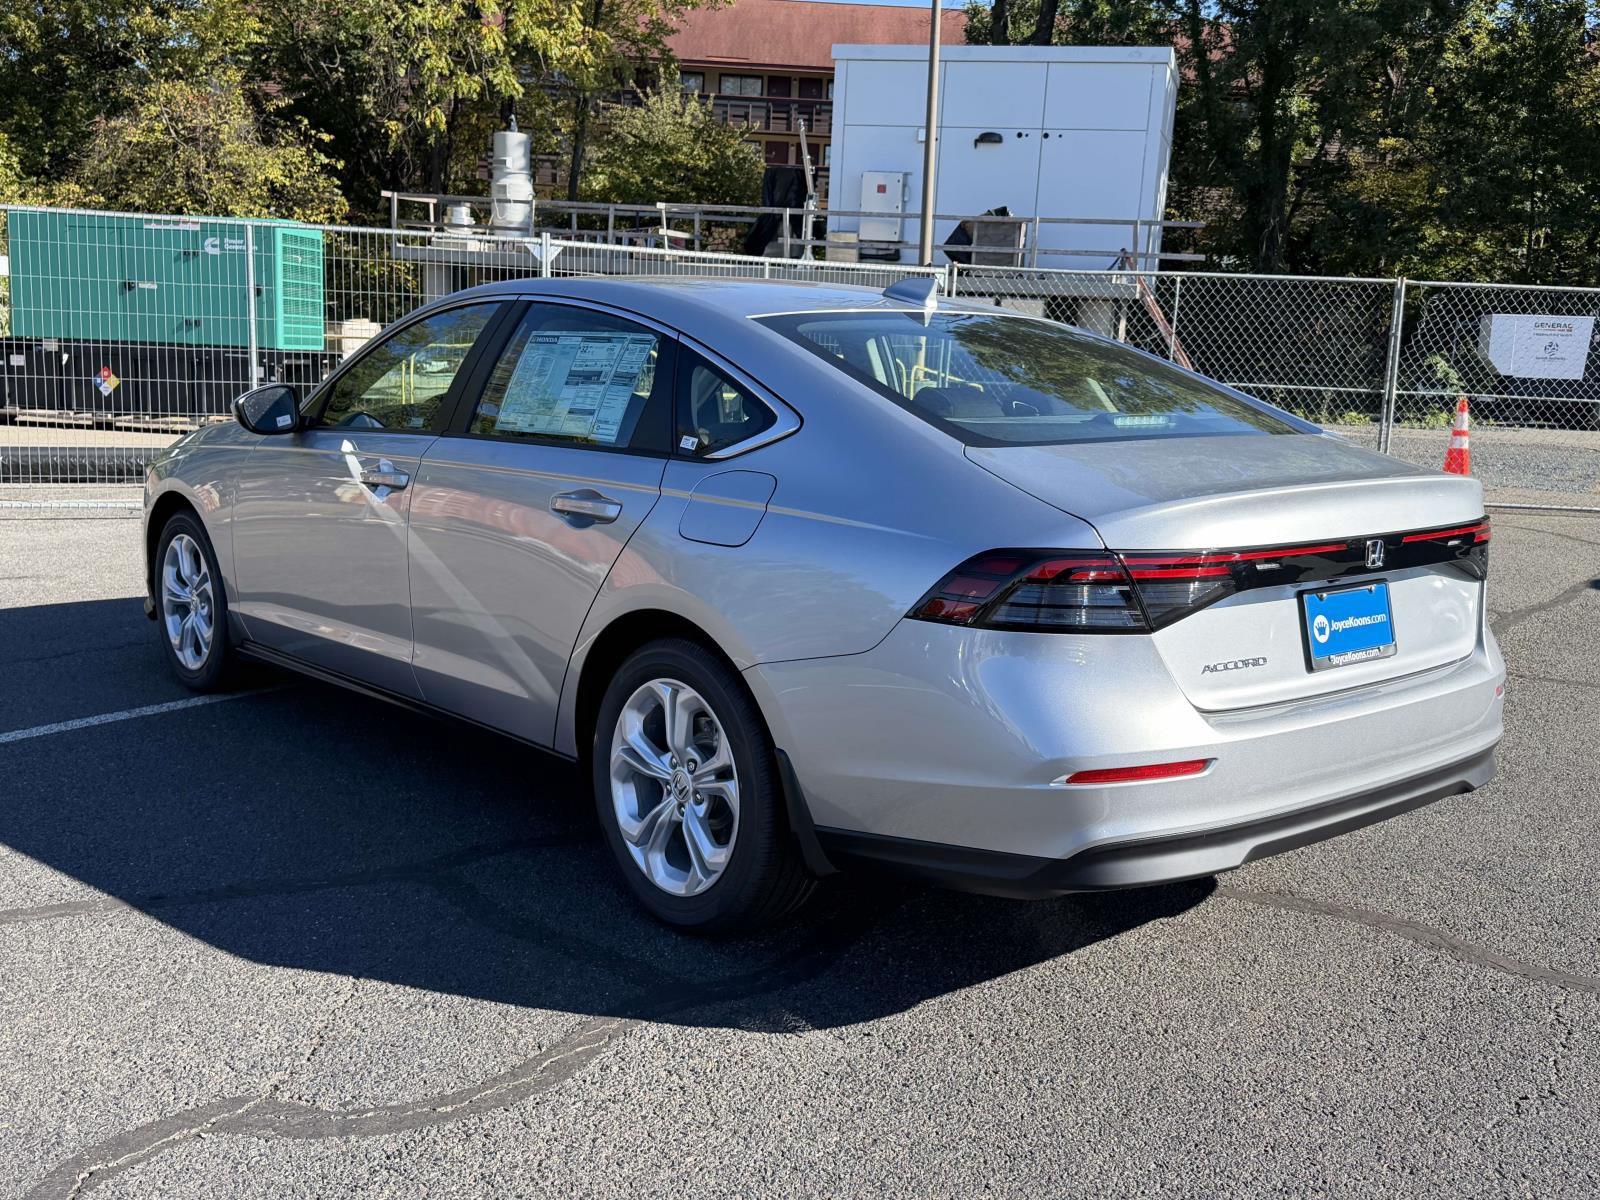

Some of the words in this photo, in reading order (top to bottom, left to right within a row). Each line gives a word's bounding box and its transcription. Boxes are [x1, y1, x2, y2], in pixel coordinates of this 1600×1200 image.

[1331, 613, 1387, 633] JoyceKoons.com
[1201, 656, 1268, 675] ACCORD
[1331, 648, 1380, 665] JoyceKoons.com
